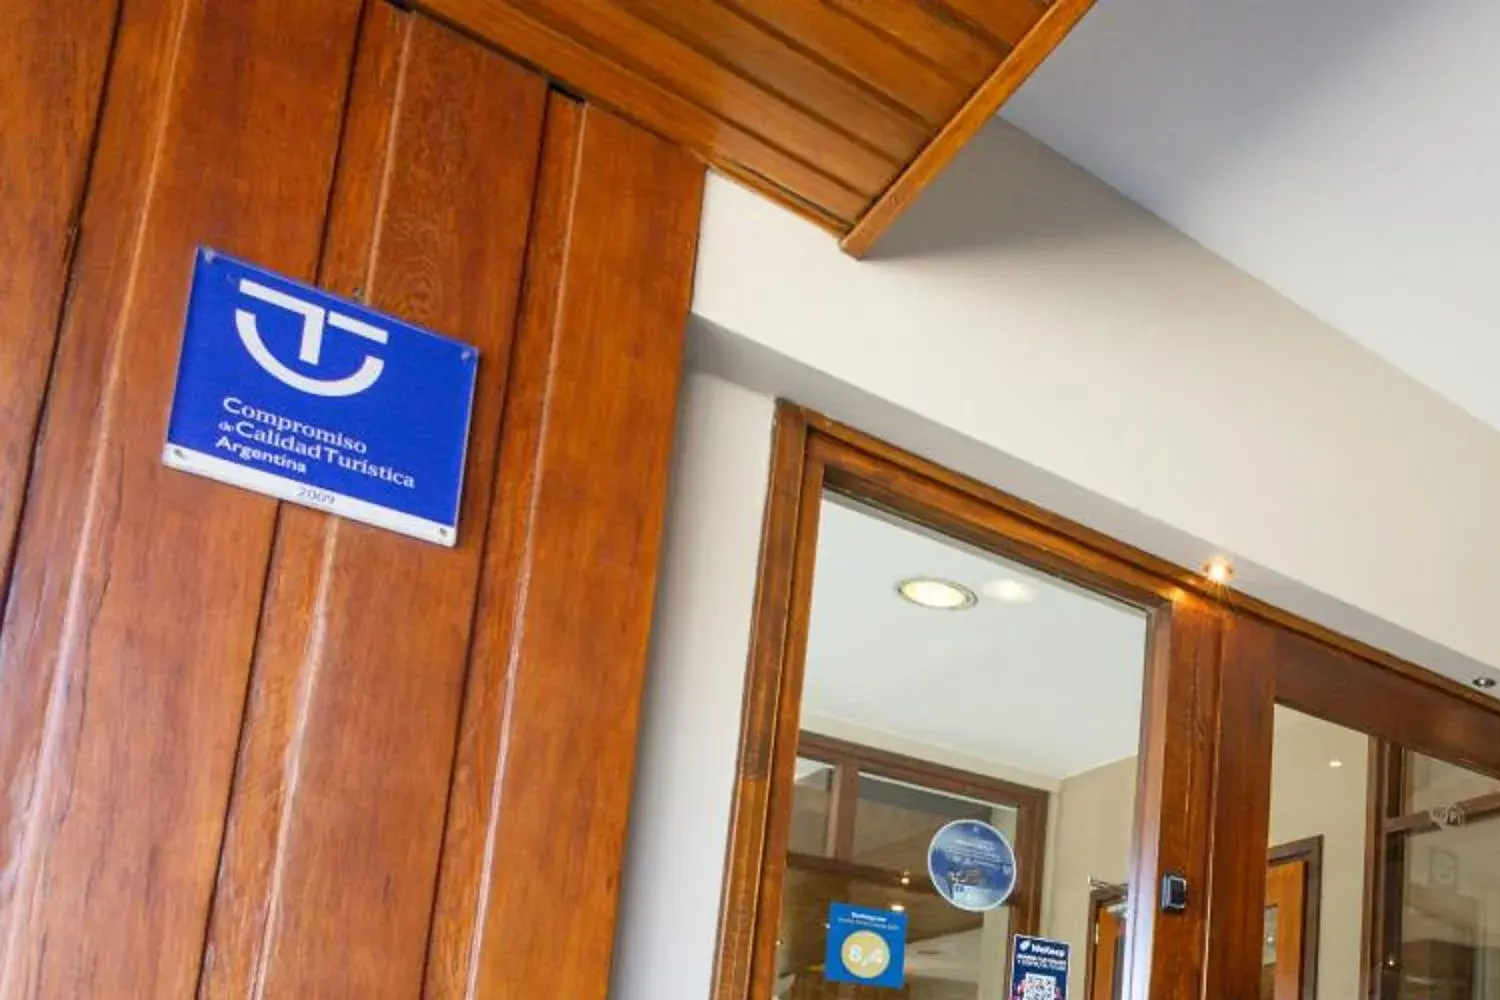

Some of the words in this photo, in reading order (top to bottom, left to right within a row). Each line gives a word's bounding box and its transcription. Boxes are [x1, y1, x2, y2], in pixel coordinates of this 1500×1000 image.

[223, 397, 368, 454] Compromiso
[235, 420, 321, 460] Calidad
[215, 435, 307, 474] Argentina
